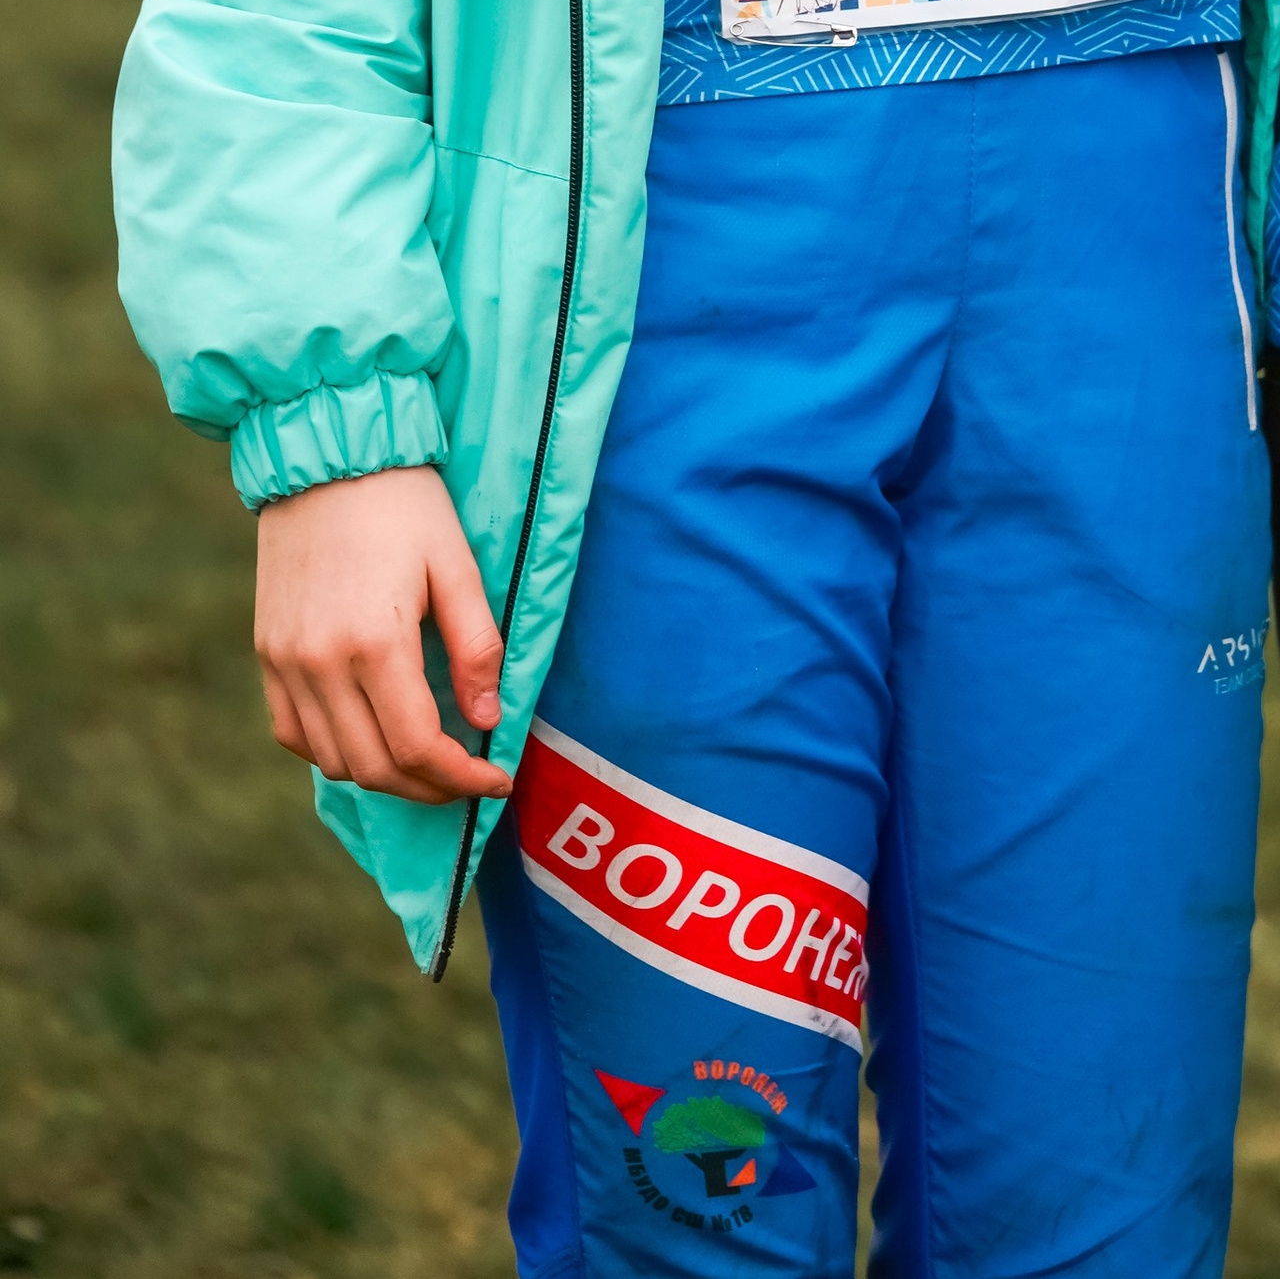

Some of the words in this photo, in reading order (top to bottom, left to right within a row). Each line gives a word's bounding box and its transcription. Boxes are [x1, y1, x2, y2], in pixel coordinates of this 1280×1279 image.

[693, 1059, 788, 1115] ВОРОНЕЖ
[671, 1206, 705, 1230] СШ
[711, 1205, 753, 1234] №18
